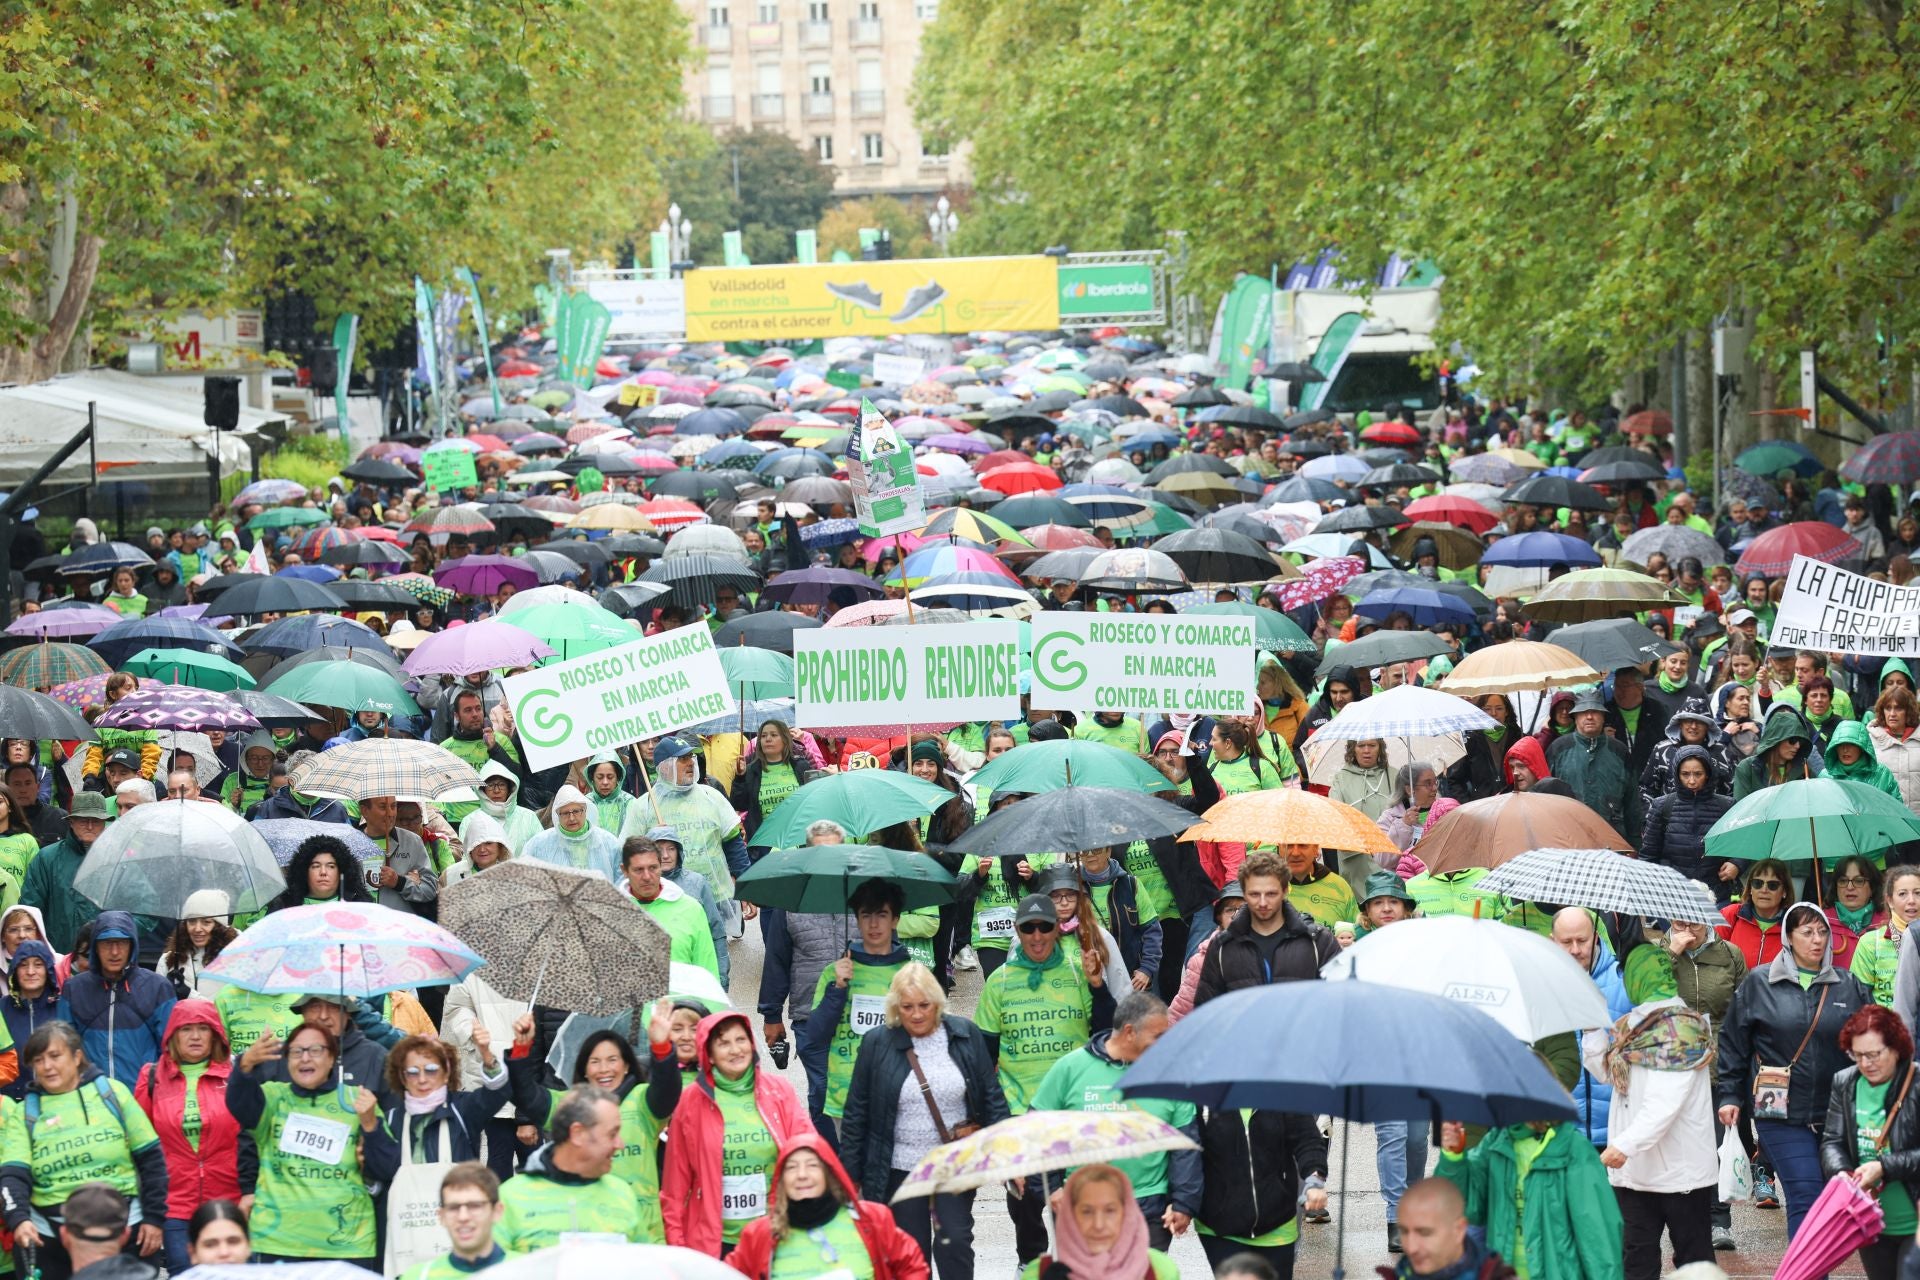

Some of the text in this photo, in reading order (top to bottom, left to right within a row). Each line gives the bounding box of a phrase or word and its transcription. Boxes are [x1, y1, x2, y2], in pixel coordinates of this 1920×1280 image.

[709, 278, 786, 292] Valladolid
[1087, 280, 1148, 297] Iberdrola
[709, 293, 790, 307] en marcha
[710, 314, 832, 331] contra el cáncer
[1797, 561, 1920, 613] LA CHUPIPA
[1820, 604, 1901, 636] CARPIO
[1090, 622, 1156, 644] RIOSECO
[1162, 625, 1172, 644] Y
[1175, 624, 1252, 646] COMARCA
[1780, 627, 1807, 646] POR
[1830, 633, 1855, 651] POR
[1879, 637, 1905, 652] POR
[559, 631, 712, 692] RIOSECO Y COMARCA
[1125, 655, 1217, 677] EN MARCHA
[797, 643, 1018, 704] PROHIBIDO RENDIRSE
[601, 670, 690, 712] EN MARCHA
[1095, 683, 1245, 711] CONTRA EL CÁNCER
[585, 692, 727, 749] CONTRA EL CÁNCER
[851, 752, 880, 770] 50
[1450, 987, 1497, 1001] ALSA
[1001, 1005, 1083, 1024] En marcha
[1006, 1024, 1054, 1040] contra
[838, 1043, 852, 1057] el
[1007, 1040, 1074, 1055] el cáncer
[1084, 1091, 1099, 1101] En
[1084, 1101, 1128, 1112] marcha
[295, 1130, 334, 1152] 17891
[34, 1152, 94, 1178] contra
[288, 1163, 349, 1179] cáncer
